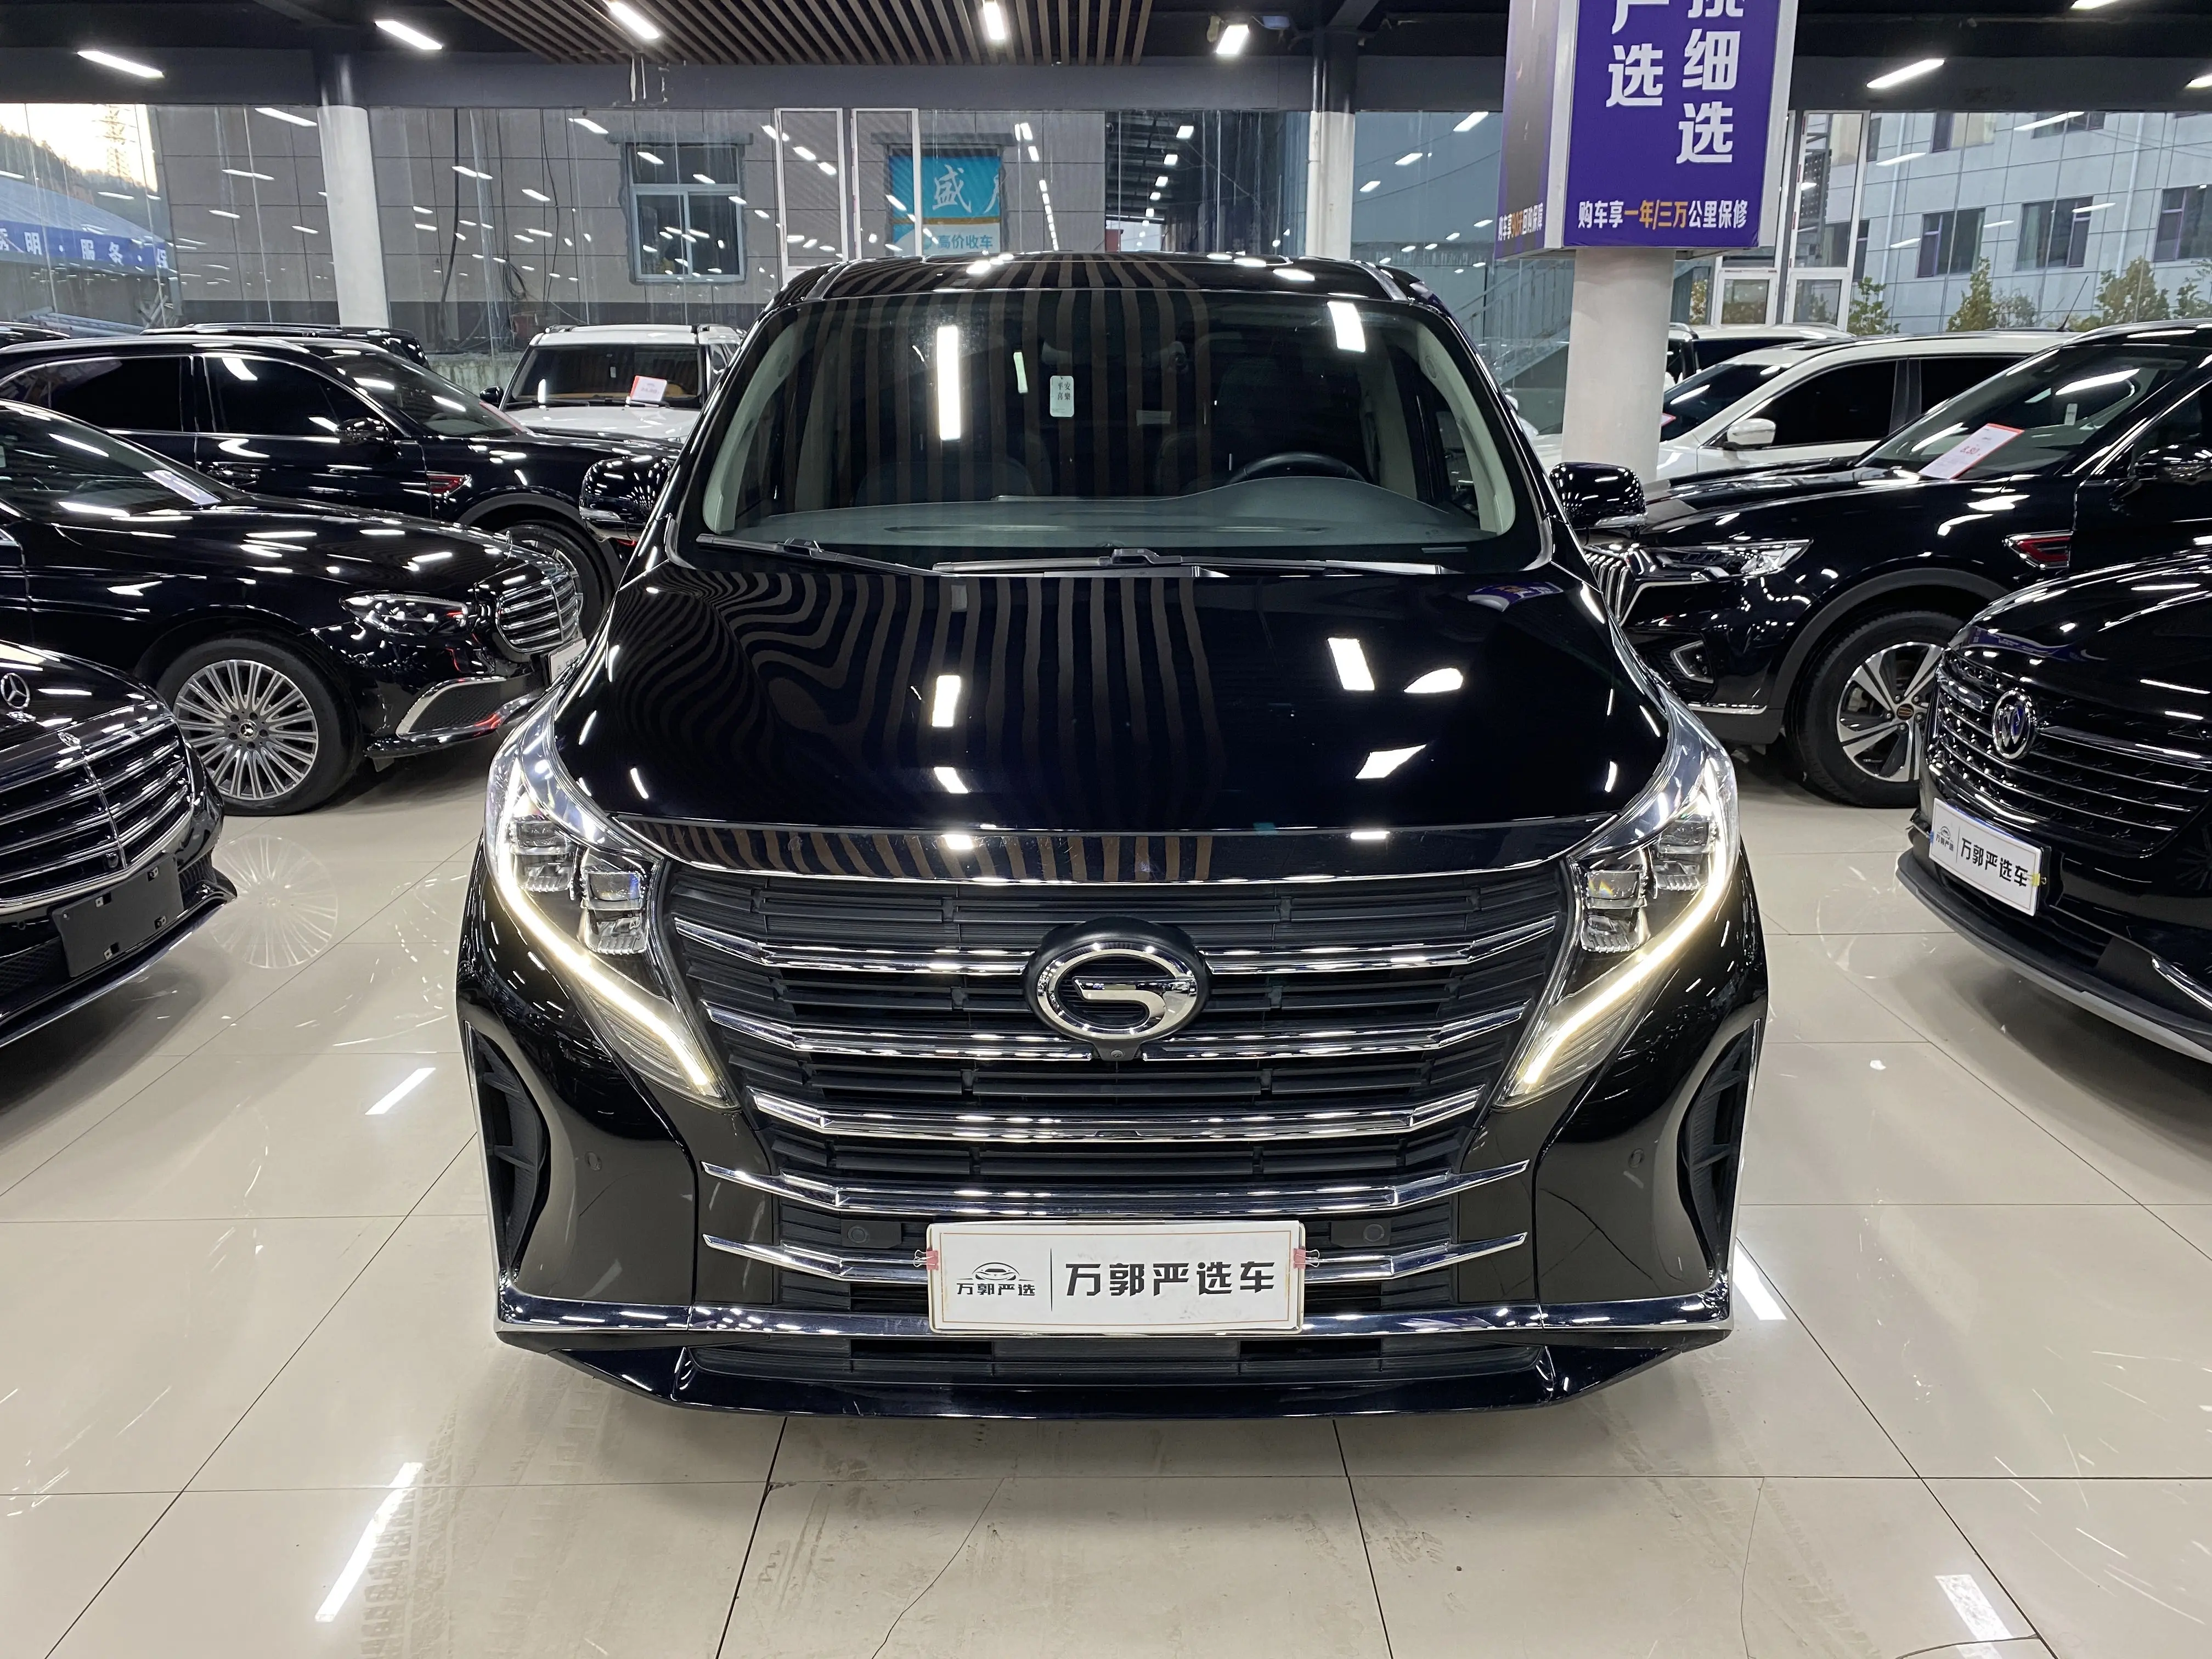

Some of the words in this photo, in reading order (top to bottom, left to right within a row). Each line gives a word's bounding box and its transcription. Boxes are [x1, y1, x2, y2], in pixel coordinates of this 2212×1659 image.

[1578, 199, 1748, 231] 购车享一年/三万公里保修
[1960, 837, 2028, 887] 万郭严选车
[956, 1283, 1036, 1296] 万郭严选
[1065, 1261, 1275, 1296] 万郭严选车
